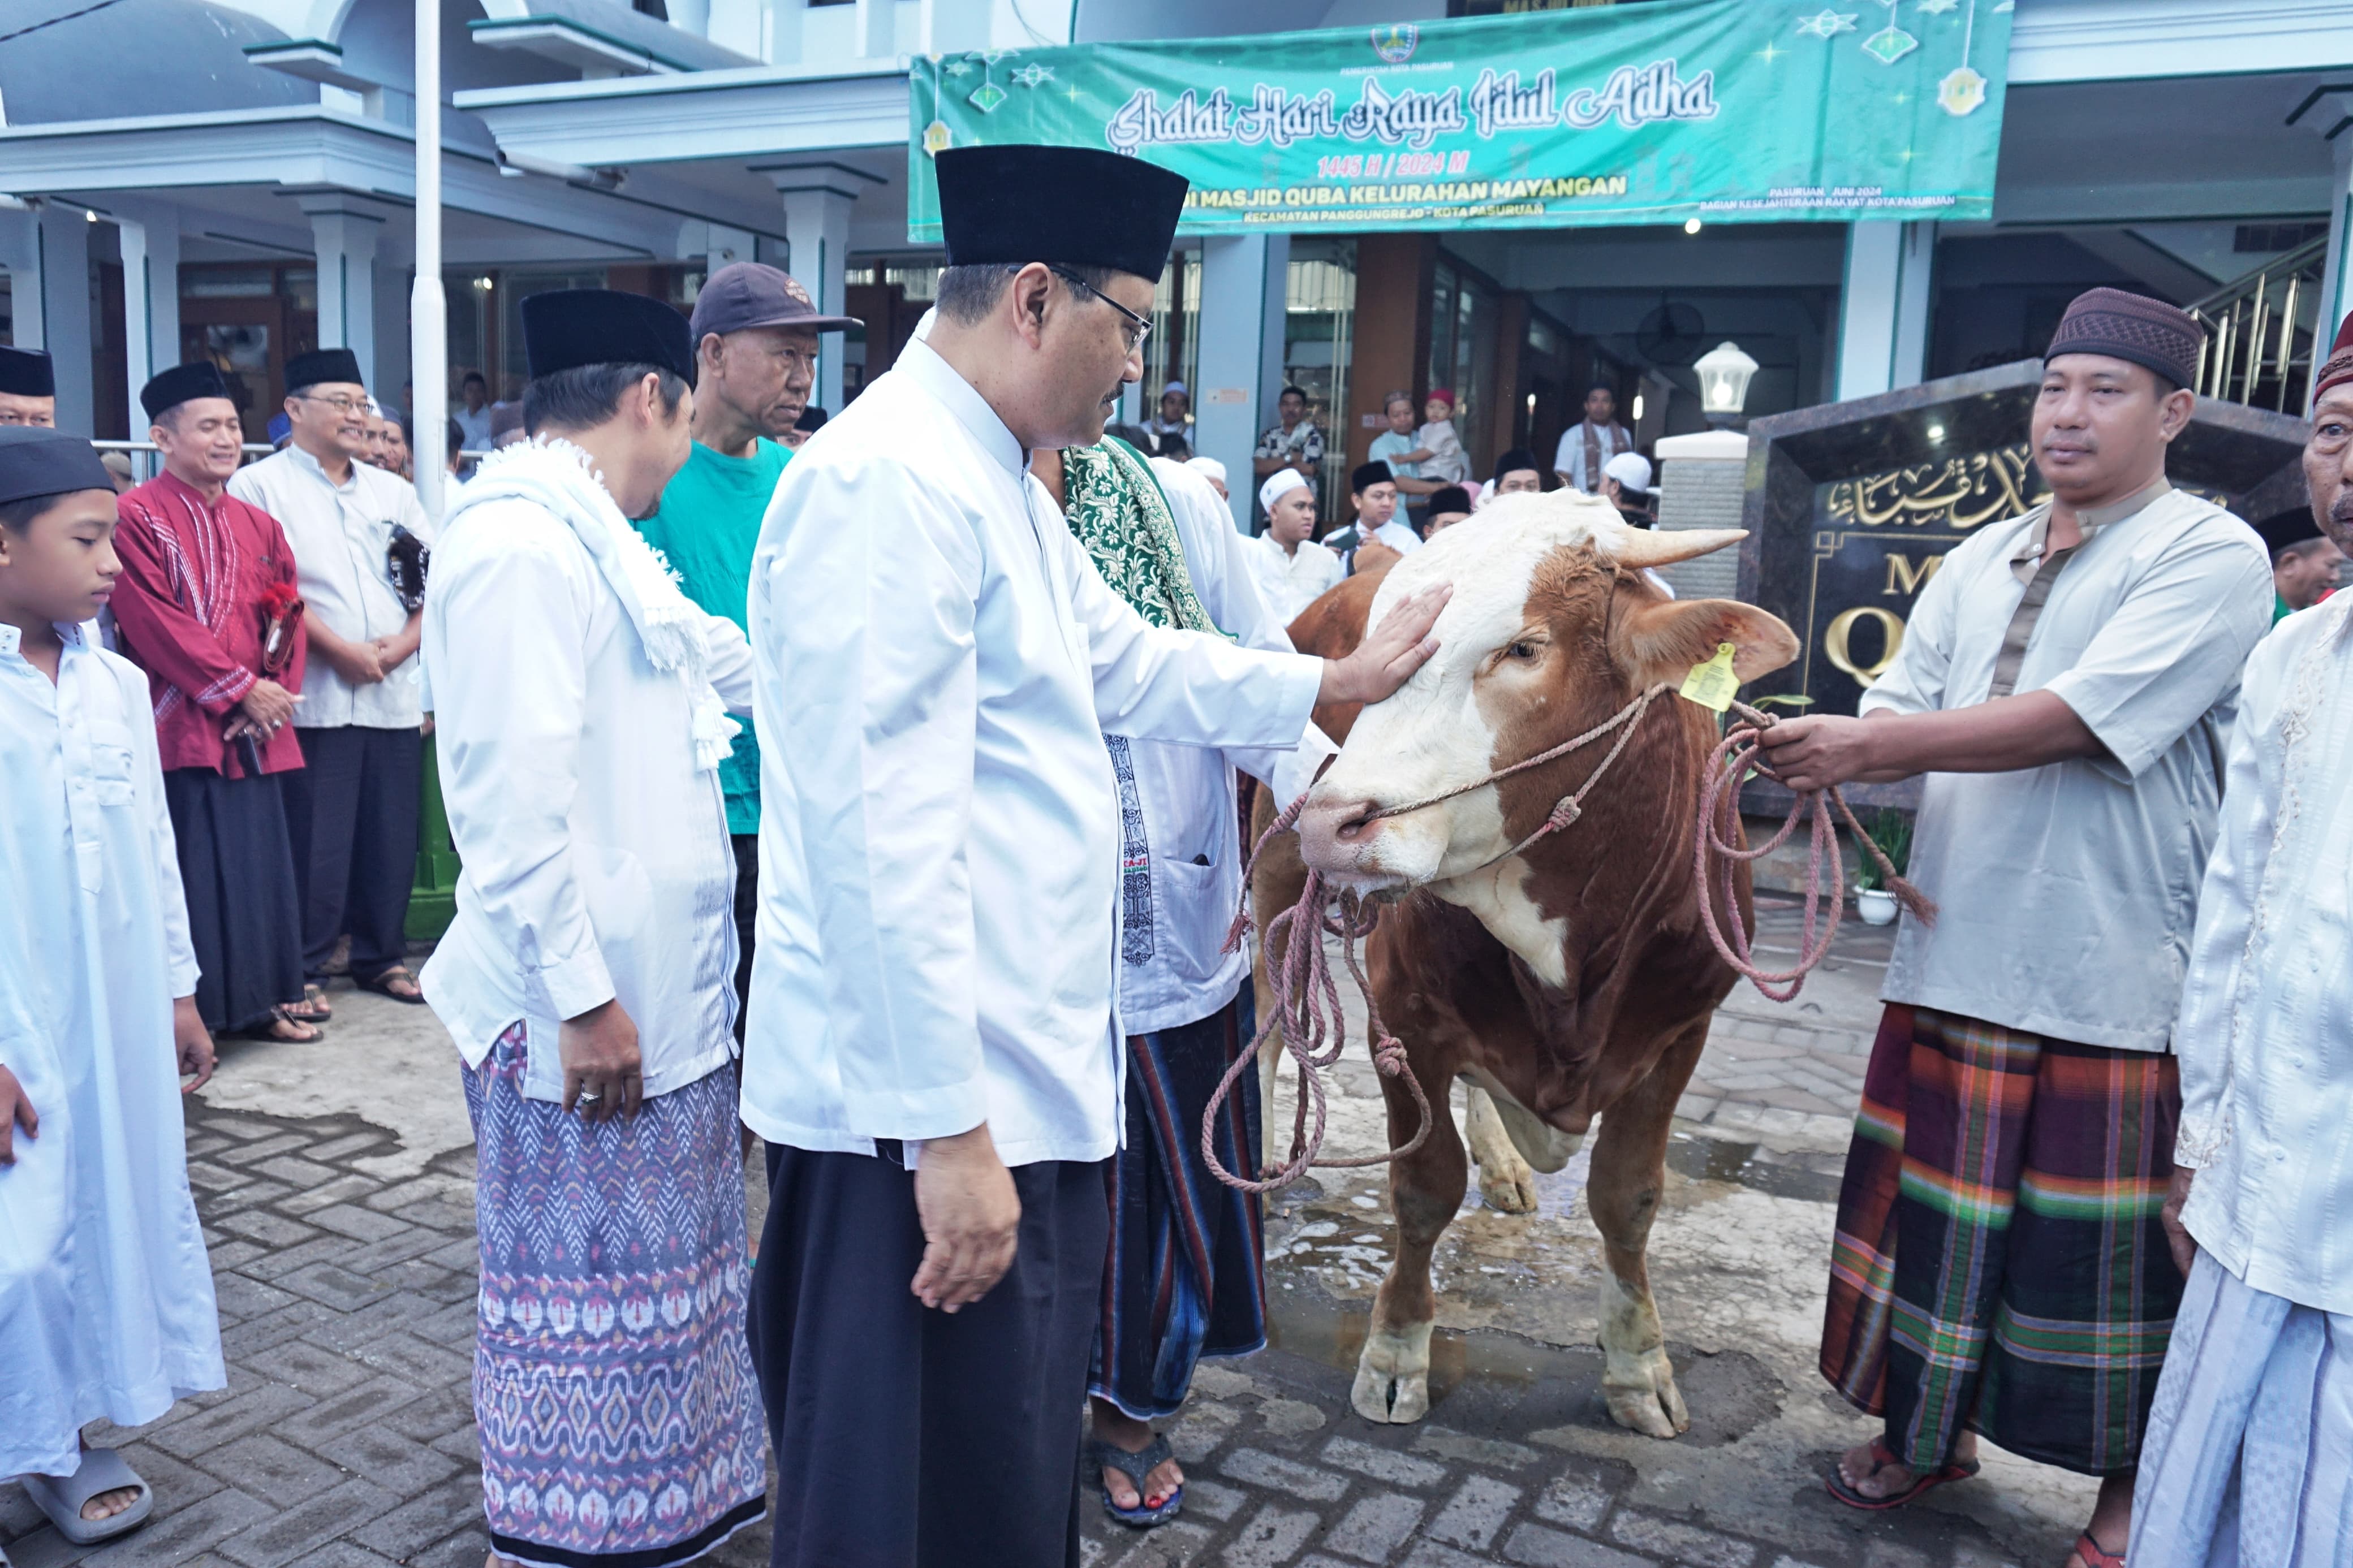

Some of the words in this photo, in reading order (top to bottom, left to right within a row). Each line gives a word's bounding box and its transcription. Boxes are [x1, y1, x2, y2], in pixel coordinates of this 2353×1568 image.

[1340, 66, 1388, 76] PEMERINTAH
[1390, 64, 1410, 73] KOTA
[1412, 61, 1454, 71] PASURUAN
[1107, 89, 1232, 155] Shalat
[1235, 84, 1338, 145] Hari
[1342, 77, 1467, 147] Raya
[1470, 68, 1559, 137] Idul
[1563, 59, 1720, 128] Adha
[1318, 155, 1363, 177] 1445
[1365, 154, 1383, 176] H
[1383, 153, 1395, 178] /
[1396, 152, 1445, 175] 2024
[1448, 150, 1469, 174] M
[1200, 188, 1282, 208] MASJID
[1285, 185, 1347, 206] QUBA
[1349, 181, 1488, 204] KELURAHAN
[1491, 176, 1627, 199] MAYANGAN
[1832, 187, 1854, 196] JUNI
[1856, 186, 1881, 196] 2024
[1700, 200, 1737, 210] BAGIAN
[1739, 198, 1823, 209] KESEJAHTERAAN
[1825, 197, 1865, 207] RAKYAT
[1867, 197, 1895, 206] KOTA
[1897, 195, 1955, 206] PASURUAN
[1244, 210, 1318, 223] KECAMATAN
[1320, 208, 1424, 221] PANGGUNGREJO
[1433, 206, 1468, 219] KOTA
[1469, 204, 1544, 217] PASURUAN
